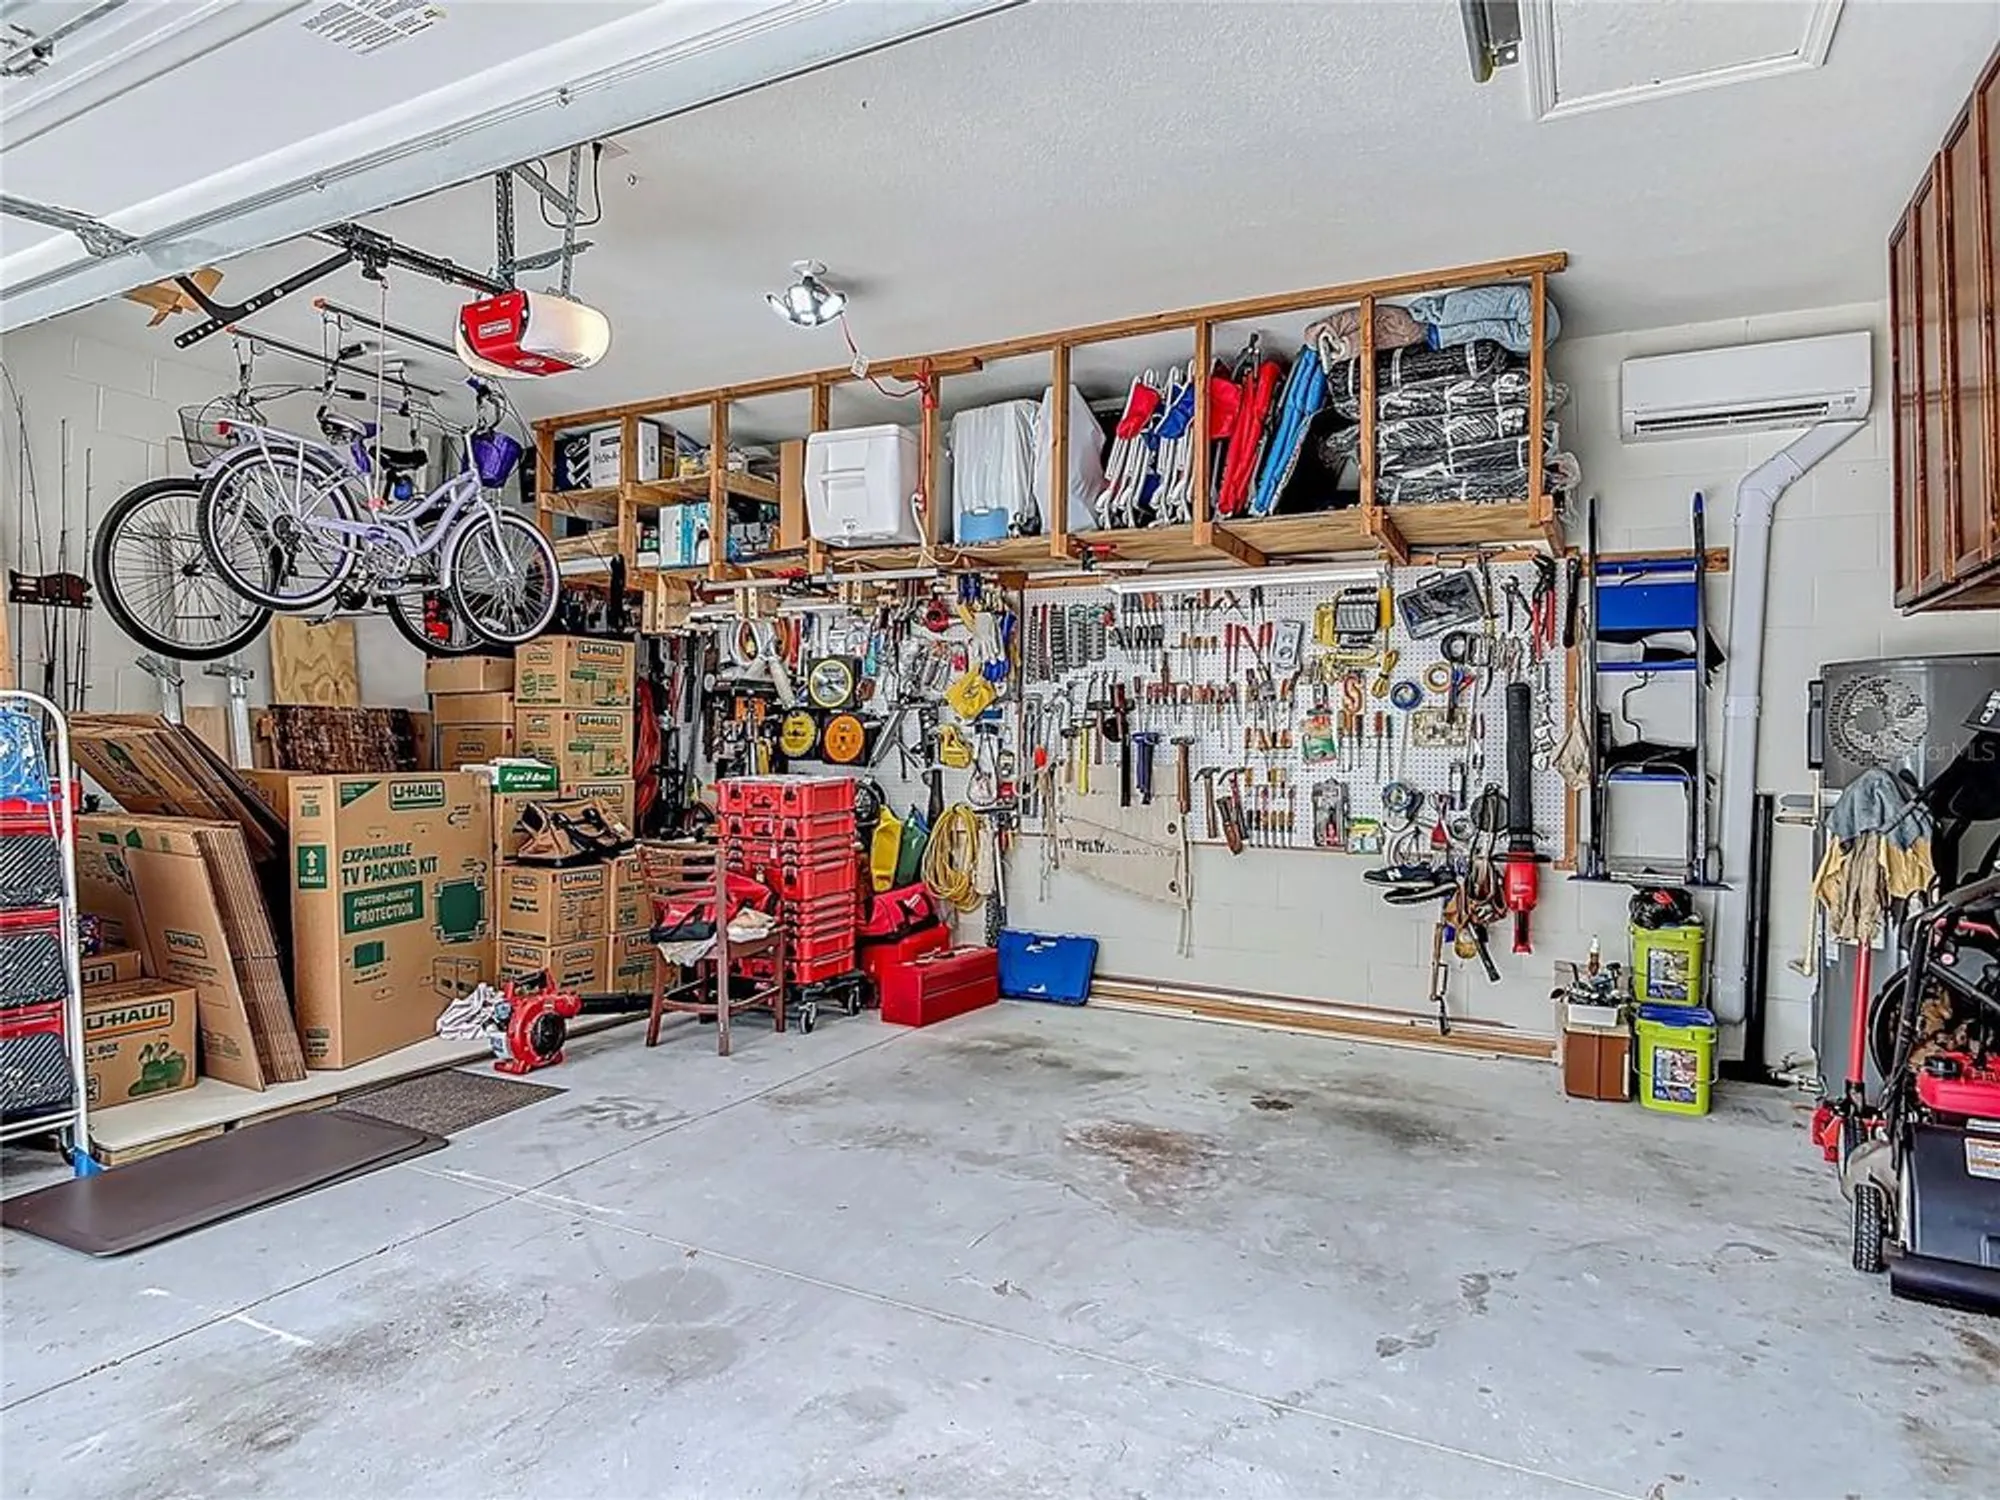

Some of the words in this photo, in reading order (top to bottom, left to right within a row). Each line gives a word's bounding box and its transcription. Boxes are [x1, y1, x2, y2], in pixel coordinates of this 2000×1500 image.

[392, 783, 442, 798] U-HAUL
[342, 843, 413, 864] EXPANDABLE
[342, 867, 361, 885] TV
[363, 861, 417, 883] PACKING
[420, 857, 438, 874] KIT
[353, 888, 415, 908] FACTORY-QUALITY
[353, 901, 414, 925] PROTECTION
[86, 1003, 170, 1030] U-HAUL
